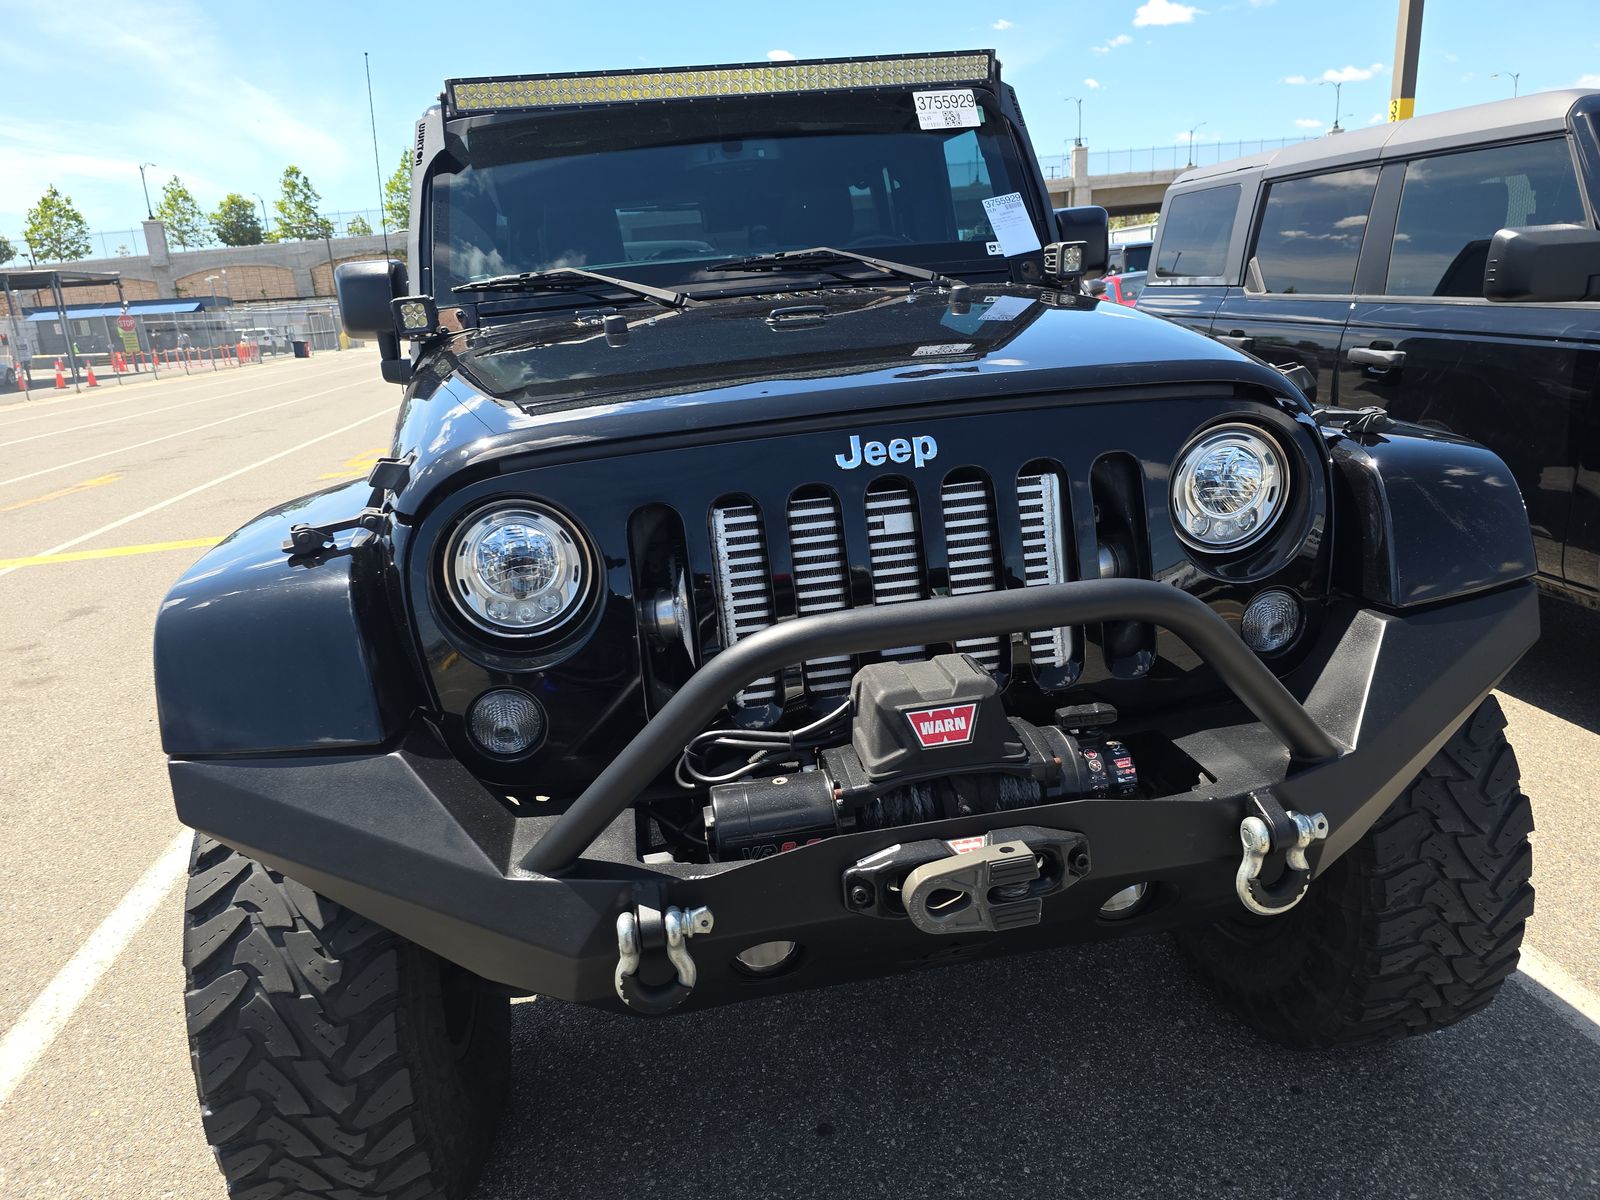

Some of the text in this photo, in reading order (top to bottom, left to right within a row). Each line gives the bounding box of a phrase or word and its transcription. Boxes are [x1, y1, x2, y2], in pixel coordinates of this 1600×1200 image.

[917, 94, 975, 110] 3755929
[984, 193, 1021, 209] 3755929
[835, 435, 938, 470] Jeep
[920, 716, 967, 736] WARN
